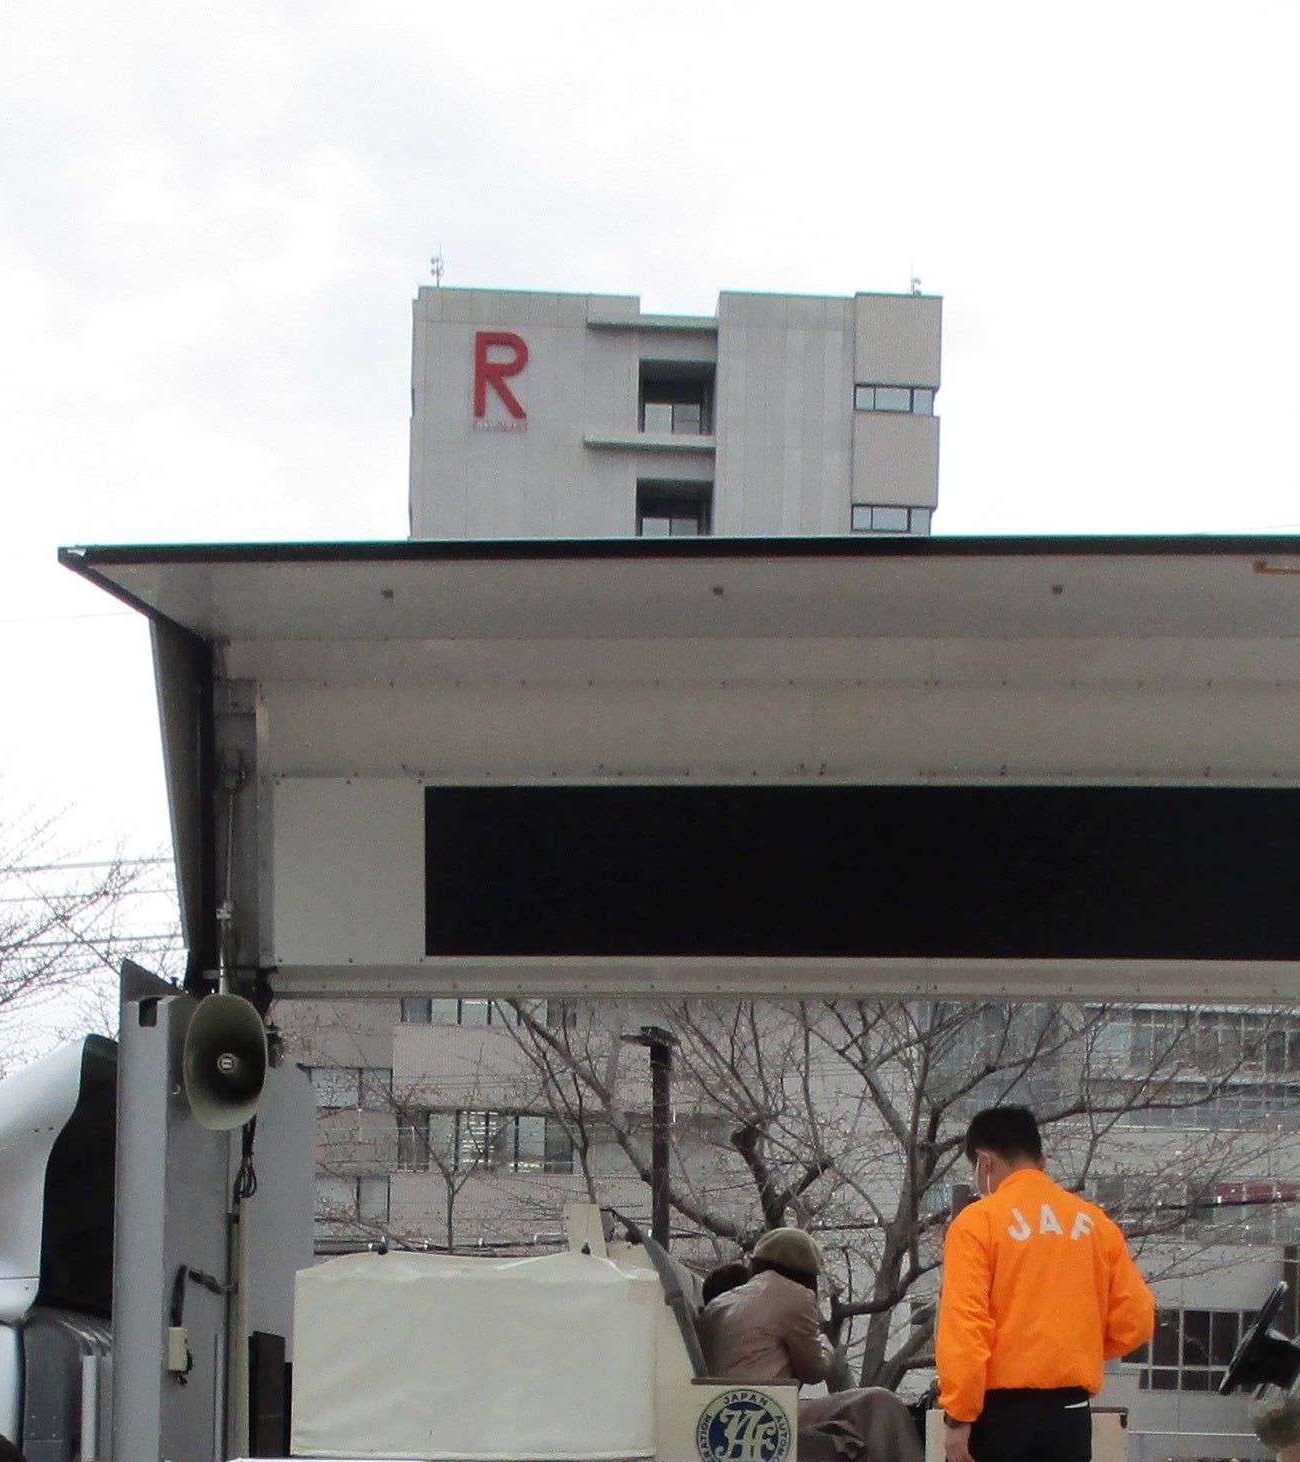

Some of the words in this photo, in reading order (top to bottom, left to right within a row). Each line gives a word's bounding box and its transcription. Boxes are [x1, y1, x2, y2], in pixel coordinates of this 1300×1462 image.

[474, 332, 528, 418] R
[1007, 1204, 1094, 1241] JAF
[723, 1393, 768, 1406] JAPAN
